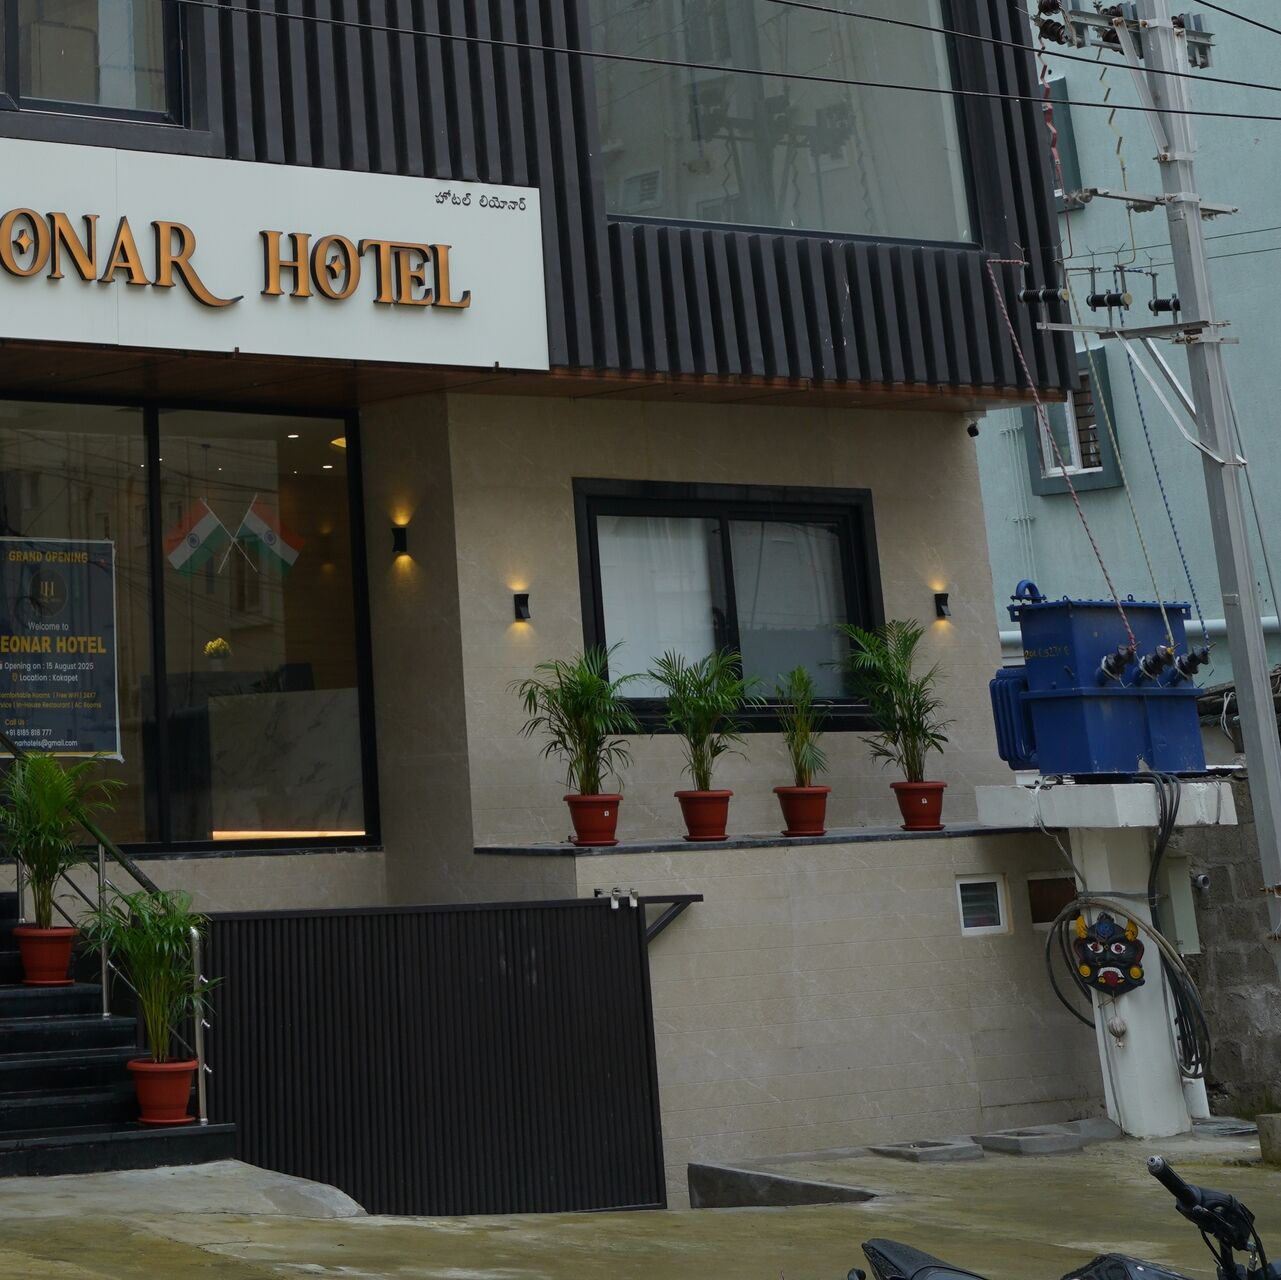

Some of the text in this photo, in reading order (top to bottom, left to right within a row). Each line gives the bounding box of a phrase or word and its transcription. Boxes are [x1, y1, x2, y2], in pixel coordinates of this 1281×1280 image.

[435, 190, 526, 211] హోటల్ లియోనార్
[258, 229, 471, 309] HOTEL
[8, 550, 88, 563] GRAND OPENING
[28, 622, 69, 631] Welcome to
[56, 636, 106, 653] HOTEL
[4, 662, 31, 671] Opening
[54, 663, 77, 671] August
[19, 673, 48, 681] Location
[52, 674, 78, 683] Kokapet
[4, 718, 17, 726] Call
[14, 739, 78, 749] narhotels@gmail.com
